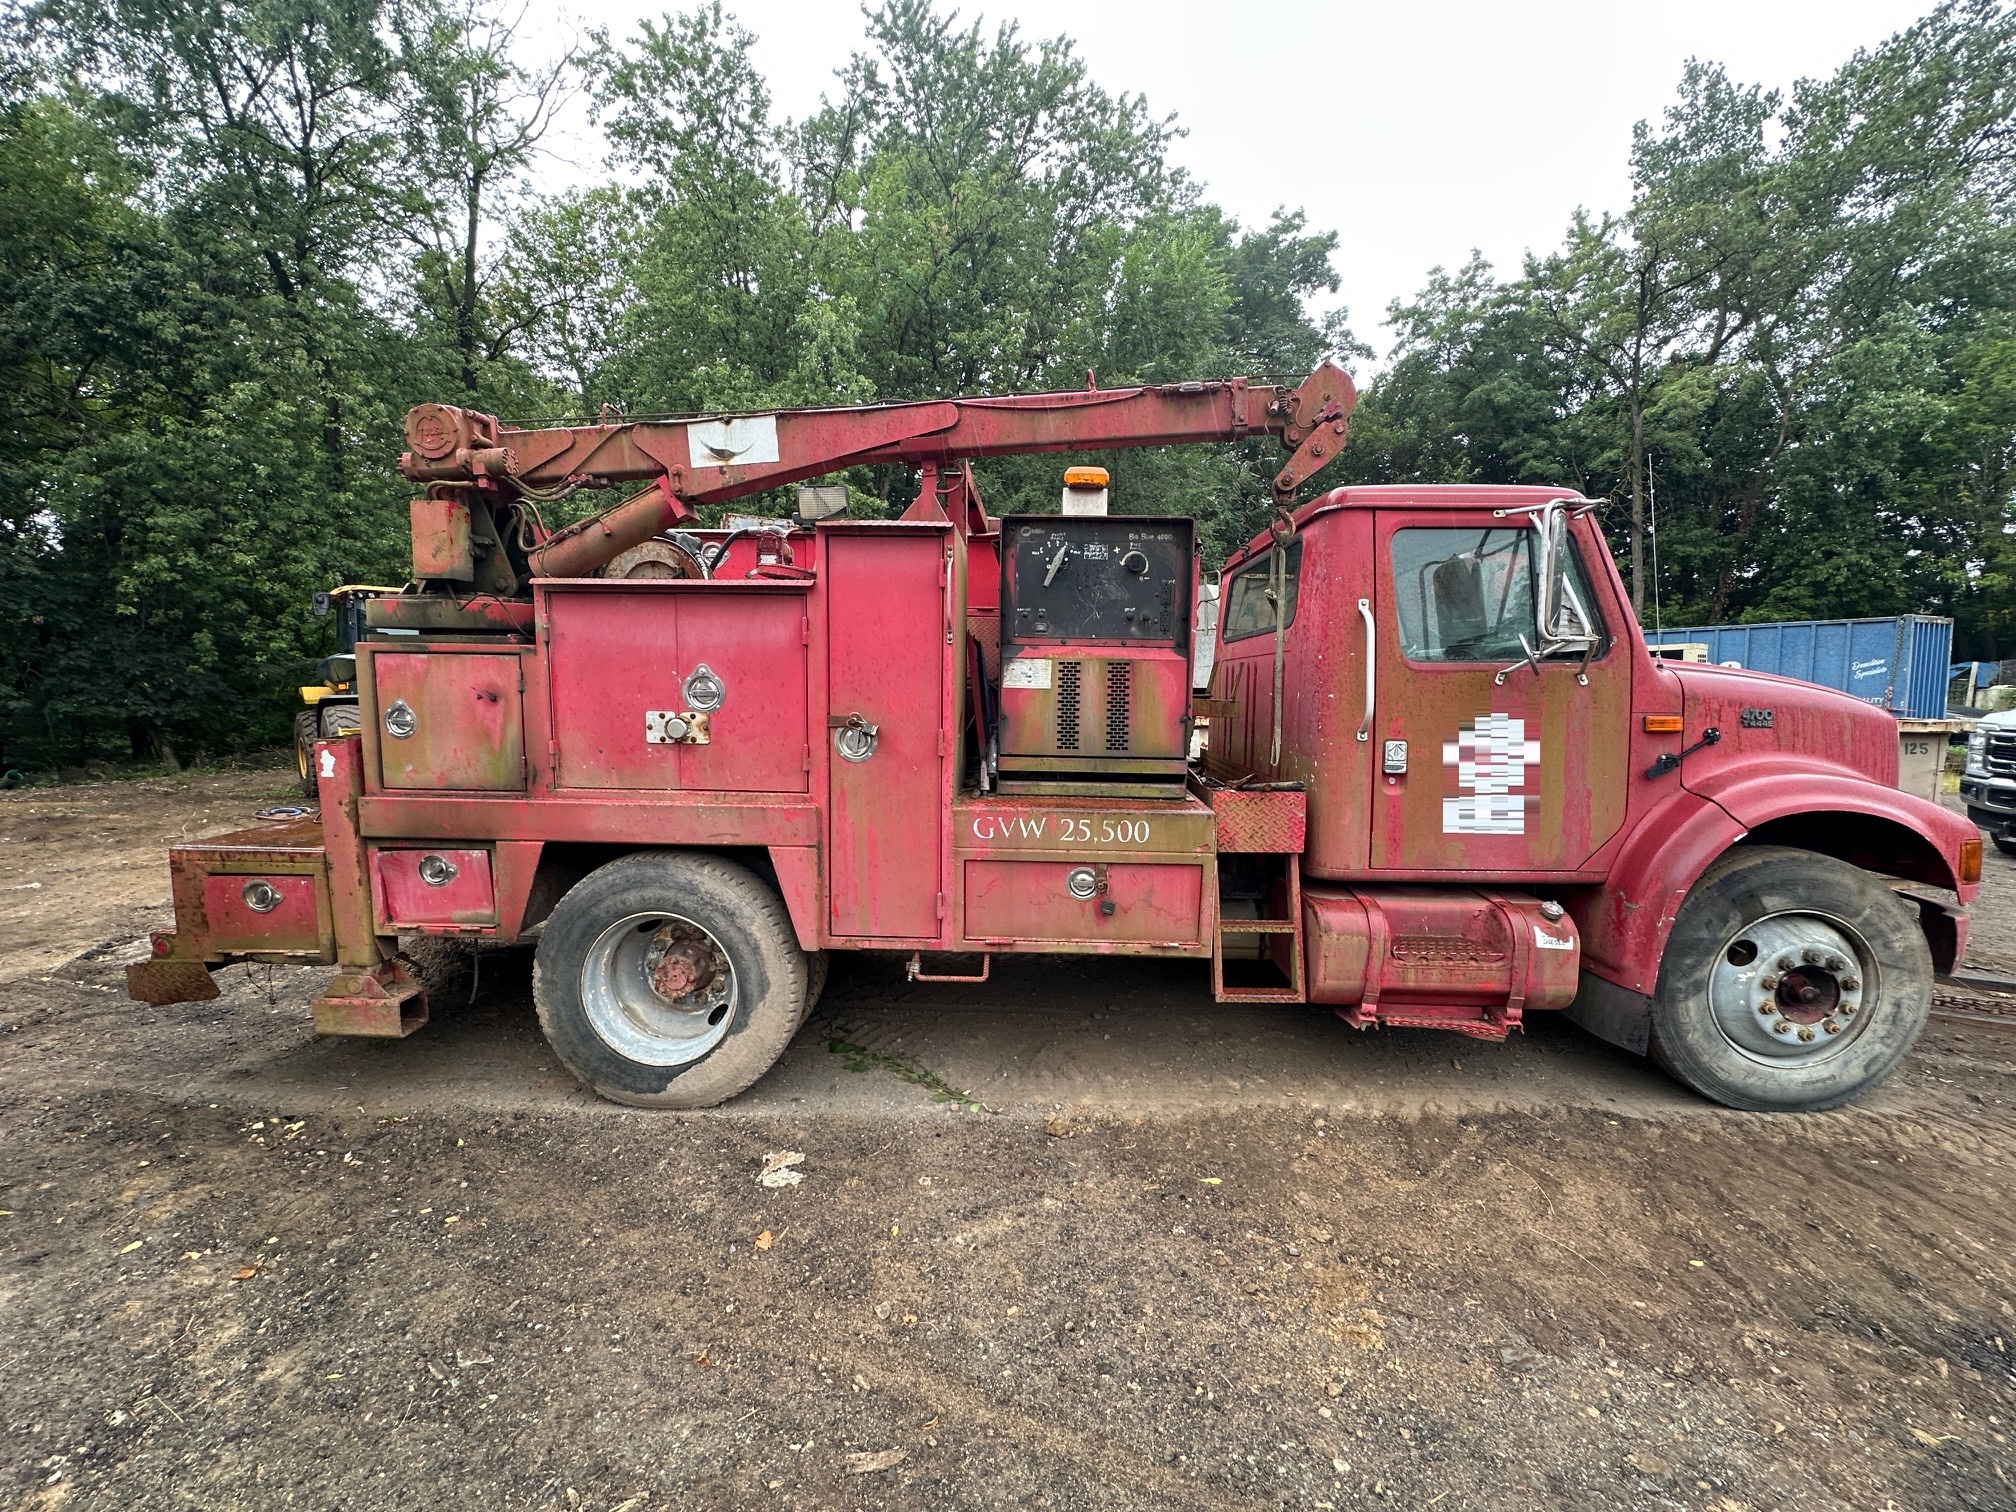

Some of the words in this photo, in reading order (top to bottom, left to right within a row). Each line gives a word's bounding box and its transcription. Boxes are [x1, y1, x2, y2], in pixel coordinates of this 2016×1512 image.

[1141, 532, 1155, 541] Blue
[1852, 658, 1885, 670] Demolition
[1742, 708, 1773, 720] 4700
[1904, 742, 1929, 755] 125
[972, 816, 1047, 840] GVW
[1059, 818, 1150, 845] 25,500
